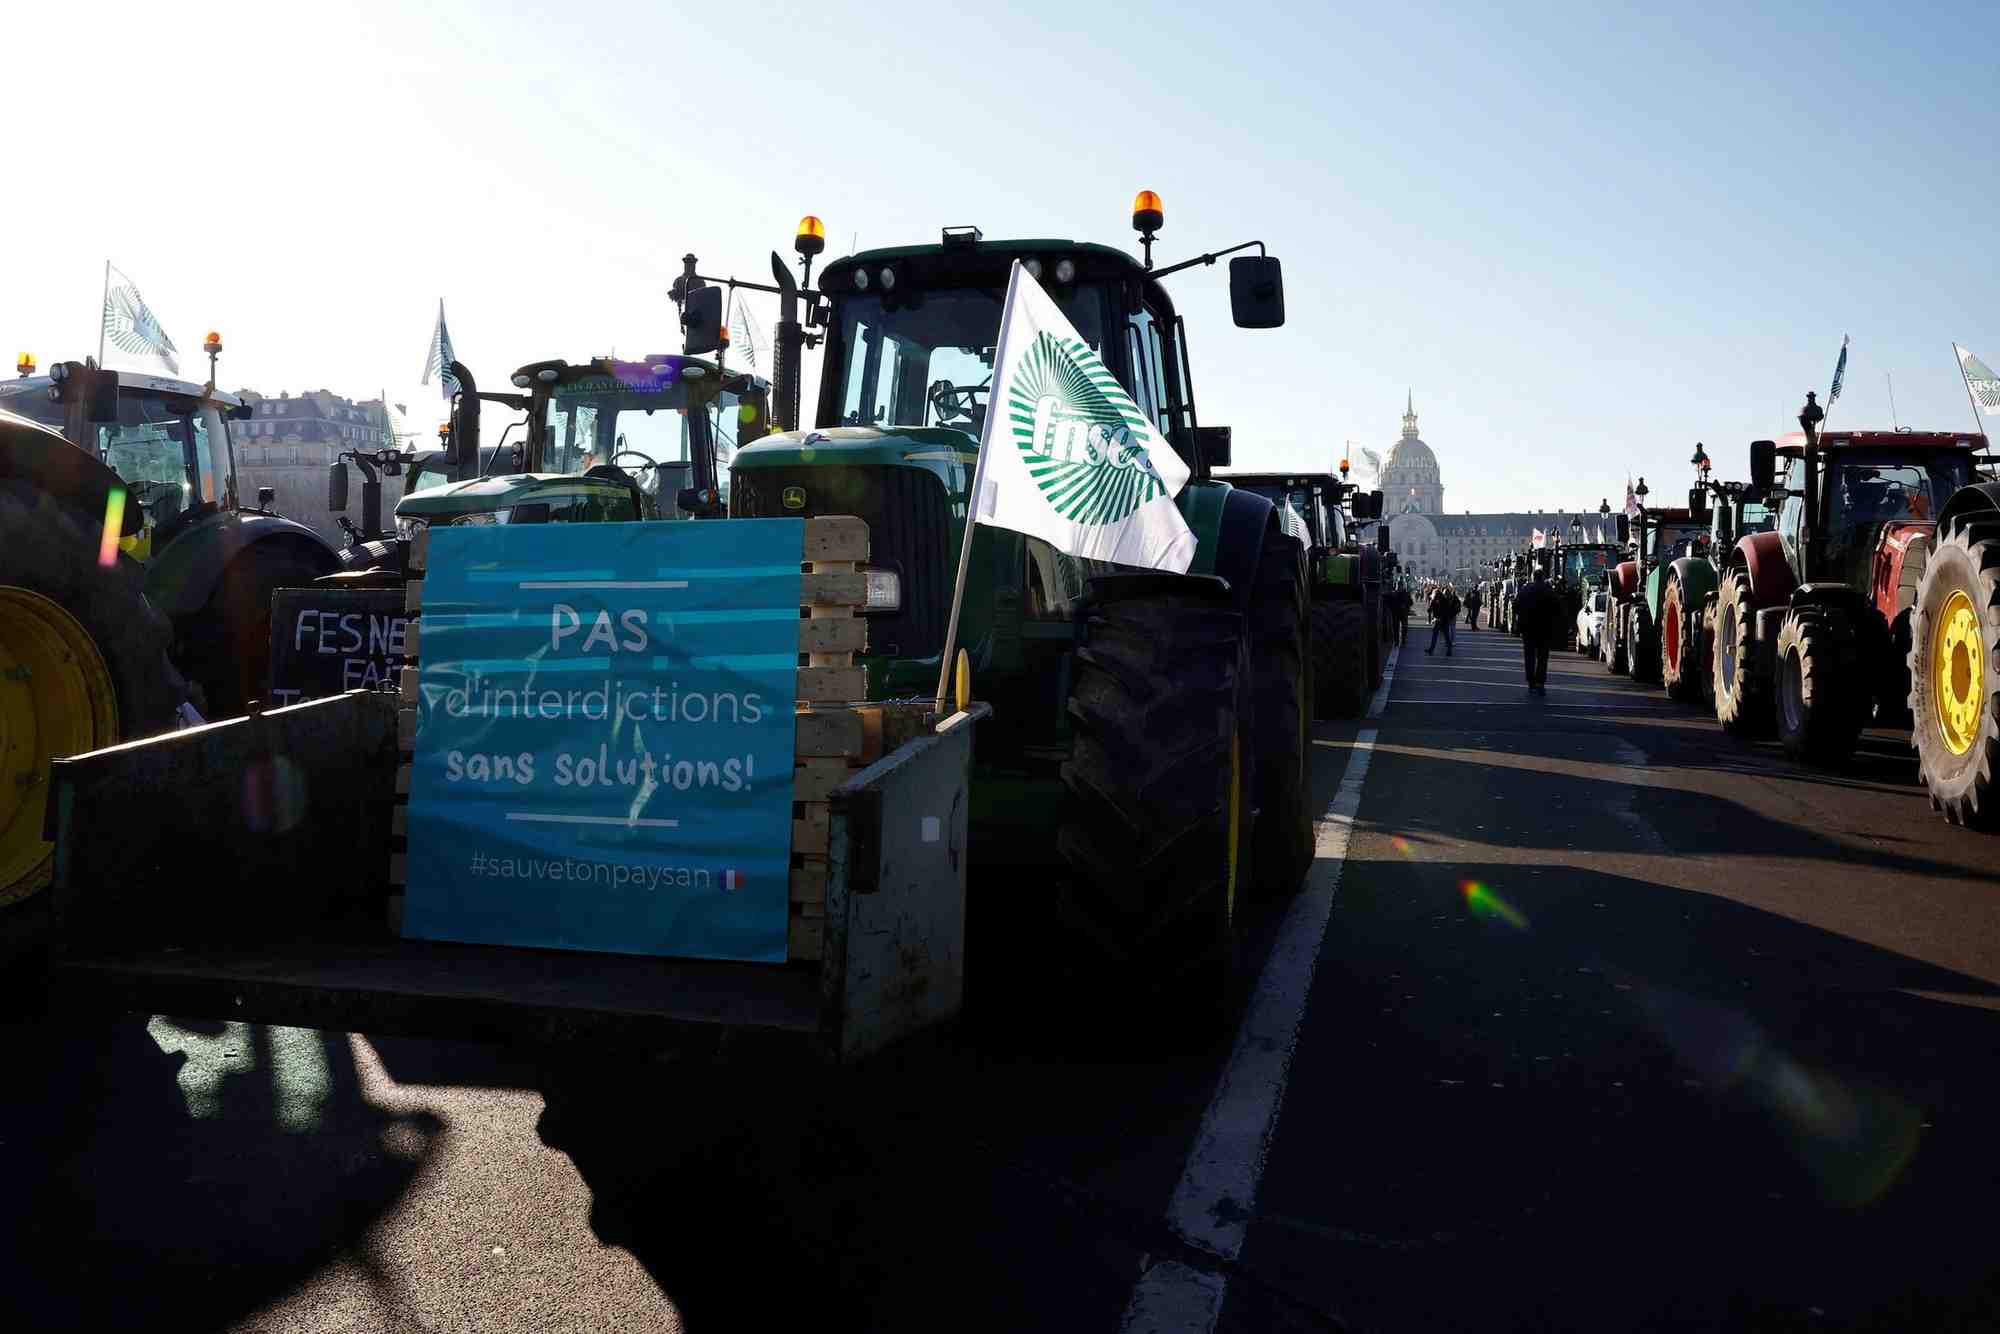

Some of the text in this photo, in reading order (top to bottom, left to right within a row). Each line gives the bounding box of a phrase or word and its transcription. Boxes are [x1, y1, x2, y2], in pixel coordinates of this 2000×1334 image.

[551, 603, 649, 652] PAS
[446, 672, 763, 724] d'interdictions
[446, 743, 754, 792] sans solutions!
[471, 849, 711, 891] #sauvetonpaysan
